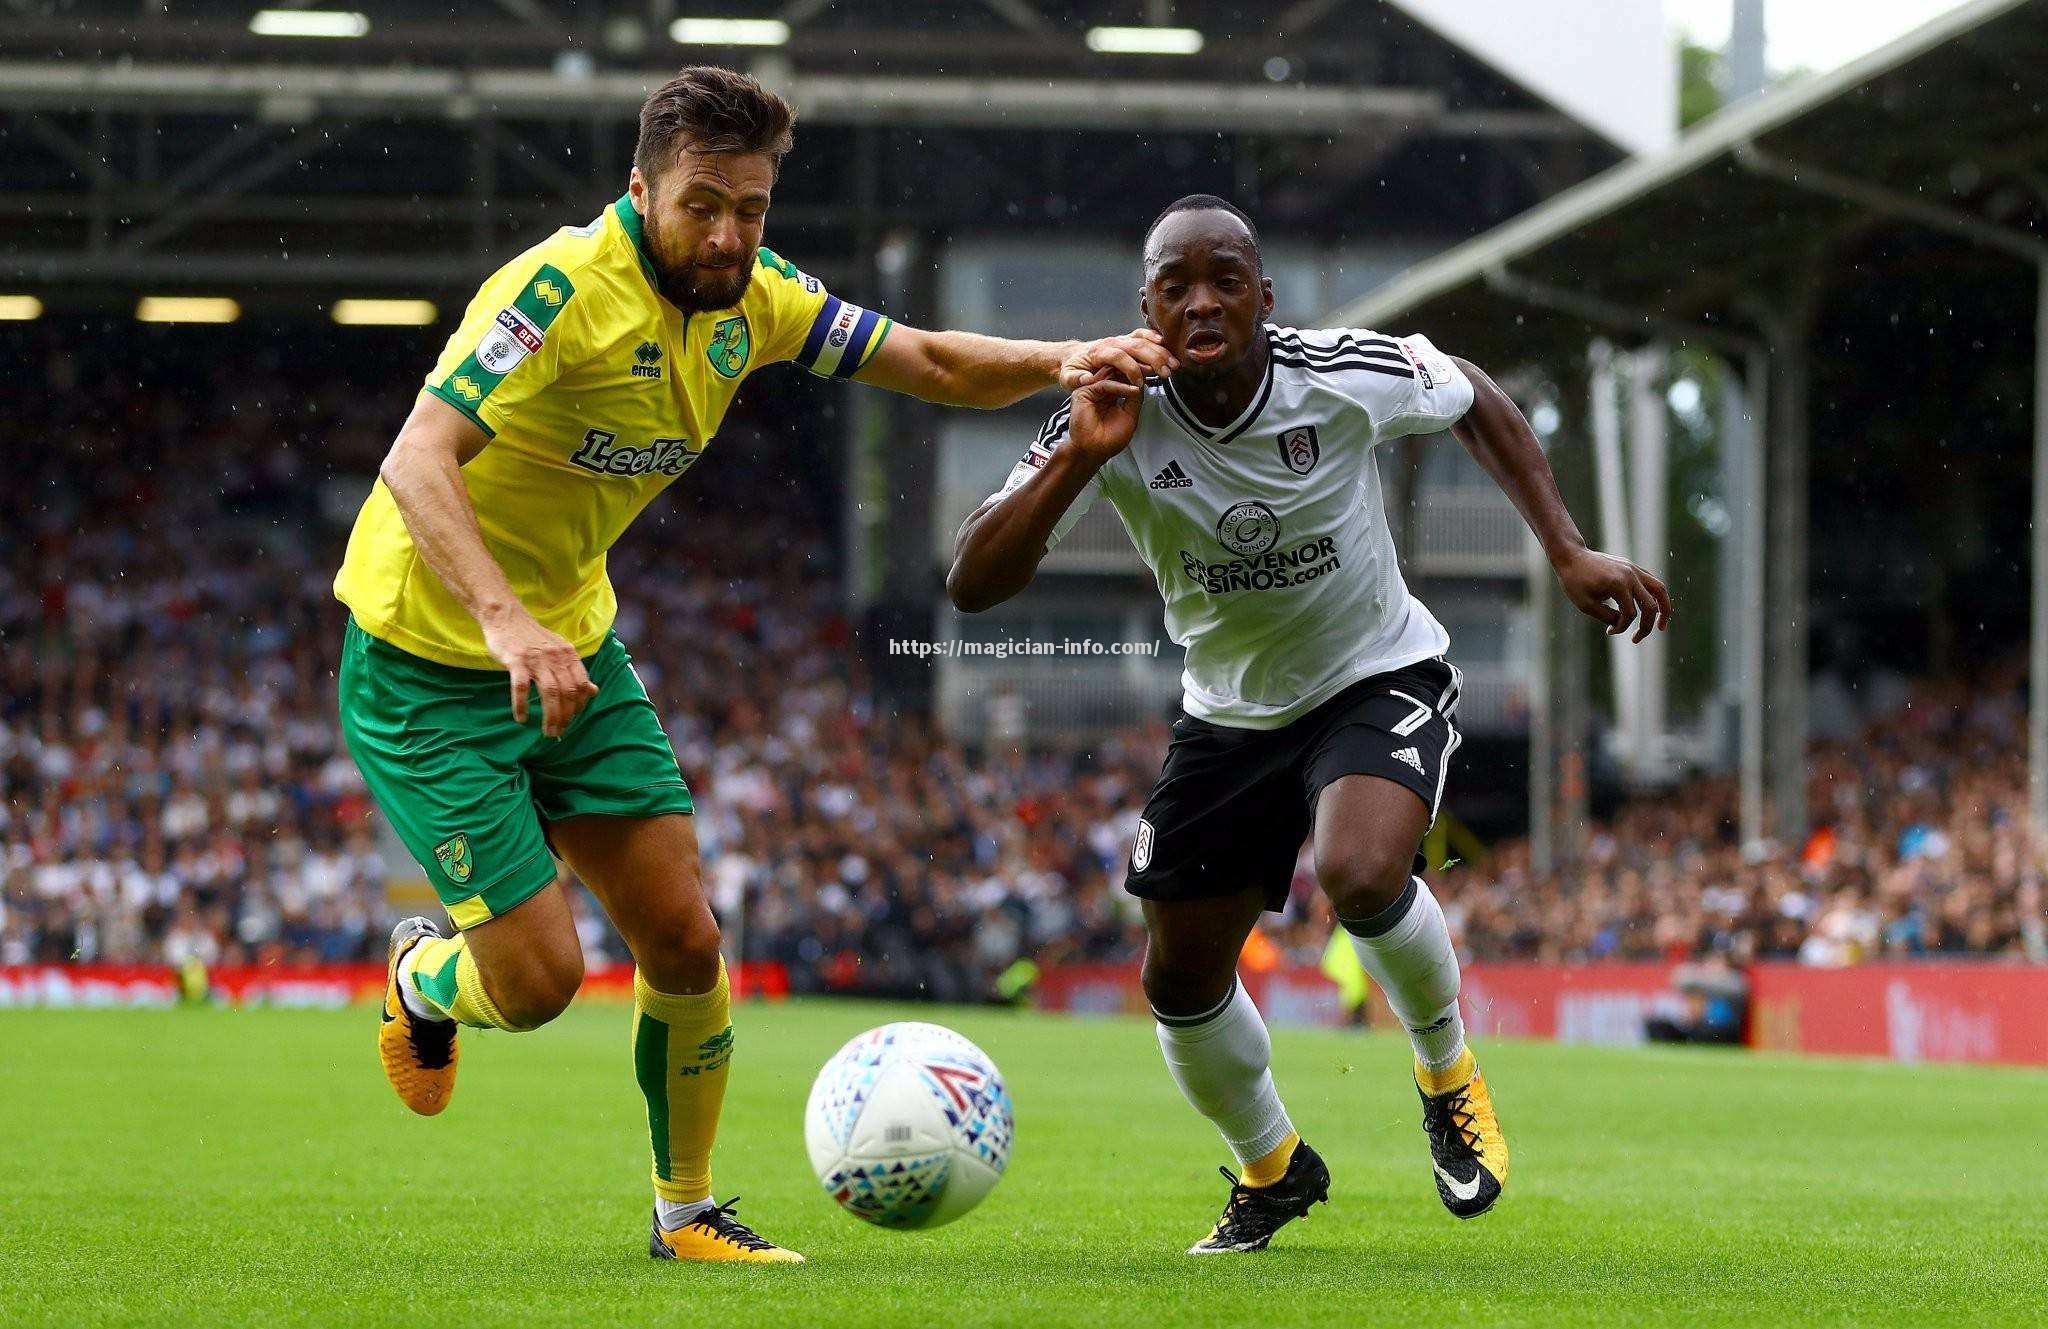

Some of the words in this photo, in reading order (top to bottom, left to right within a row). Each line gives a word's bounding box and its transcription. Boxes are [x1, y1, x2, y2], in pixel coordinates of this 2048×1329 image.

[839, 312, 856, 329] EFL
[518, 328, 540, 349] BET
[484, 353, 497, 366] EFL
[1034, 454, 1049, 469] BE
[1150, 477, 1194, 490] adidas
[1223, 508, 1272, 534] GROSVENOR
[1231, 535, 1271, 553] CASINOS
[1179, 536, 1338, 579] GROSVENOR
[1183, 556, 1341, 595] CASINOS.com
[1389, 689, 1433, 738] 7
[1391, 751, 1425, 776] adidas
